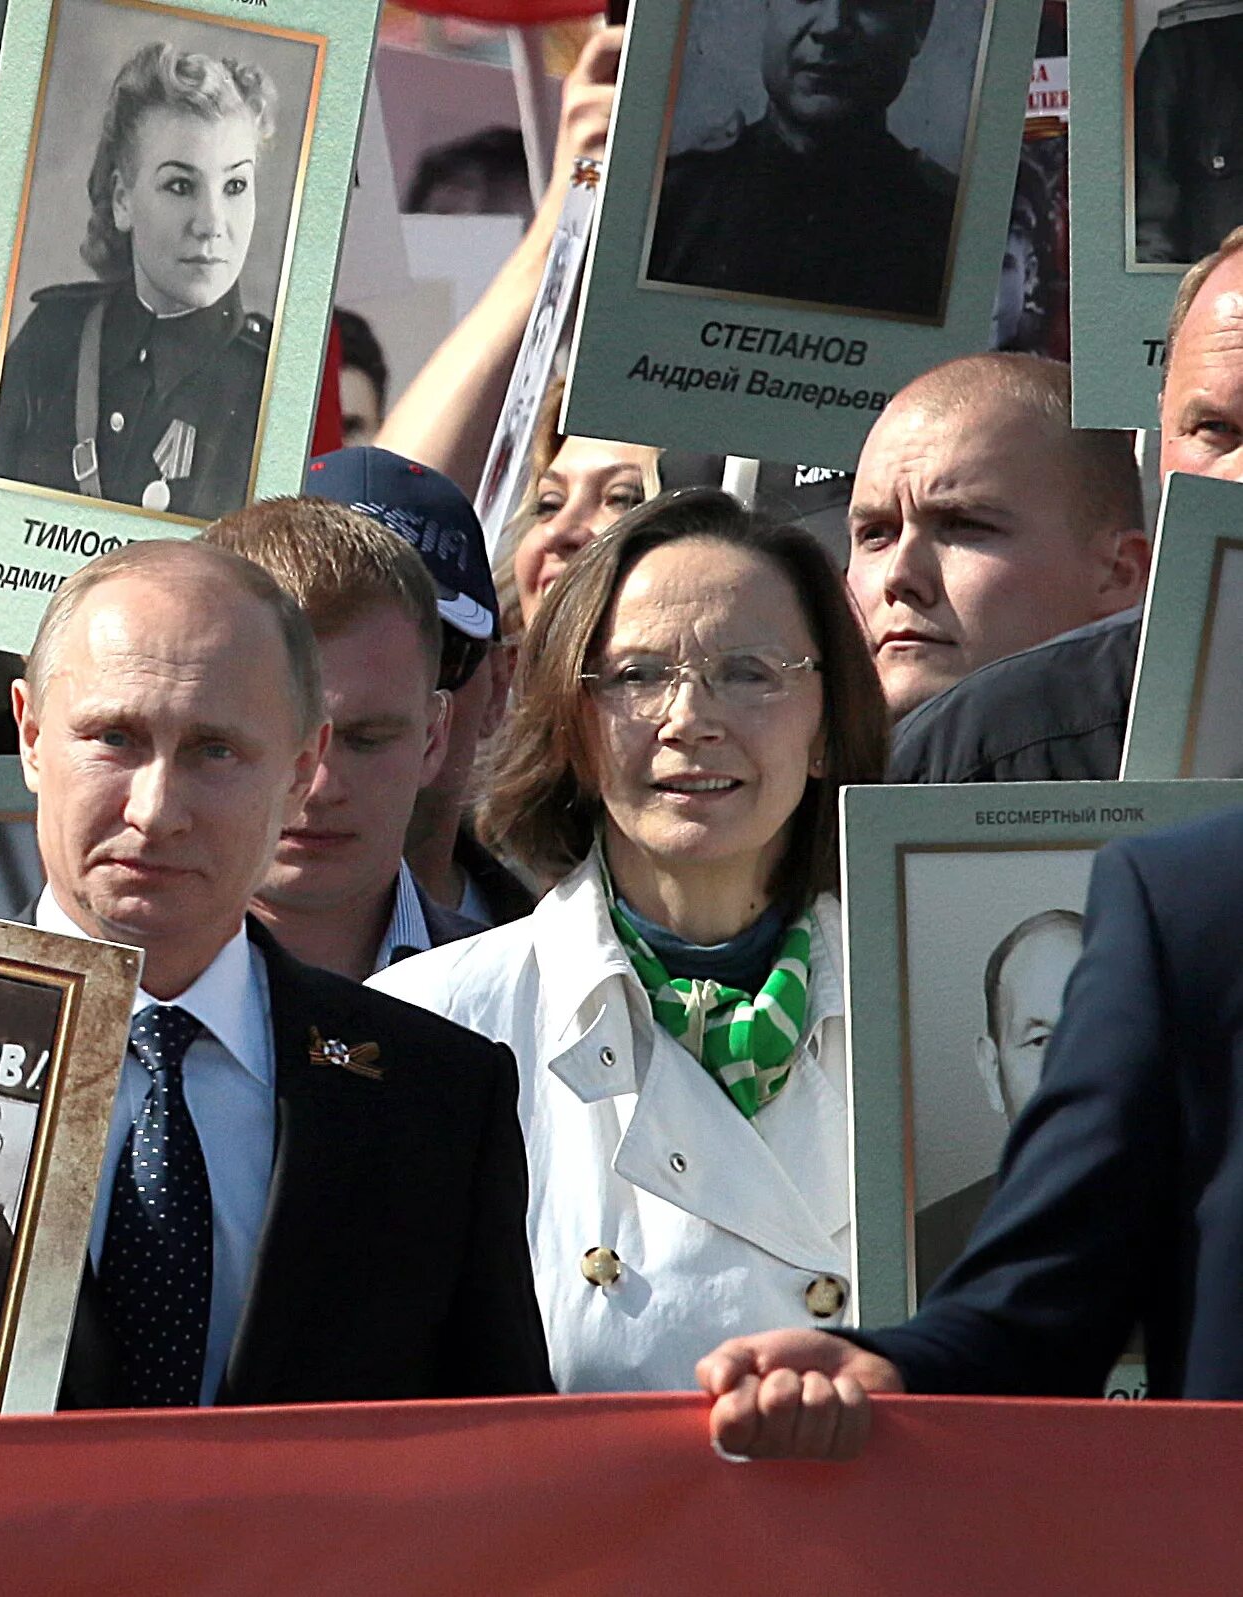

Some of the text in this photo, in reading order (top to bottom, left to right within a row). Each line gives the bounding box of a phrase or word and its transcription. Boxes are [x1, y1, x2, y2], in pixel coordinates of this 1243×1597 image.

[700, 321, 868, 366] СТЕПАНОВ
[627, 354, 894, 411] Андрей Валерьев
[23, 517, 142, 557] ТИМОФ
[975, 807, 1144, 826] БЕССМЕРТНЫЙ ПОЛК
